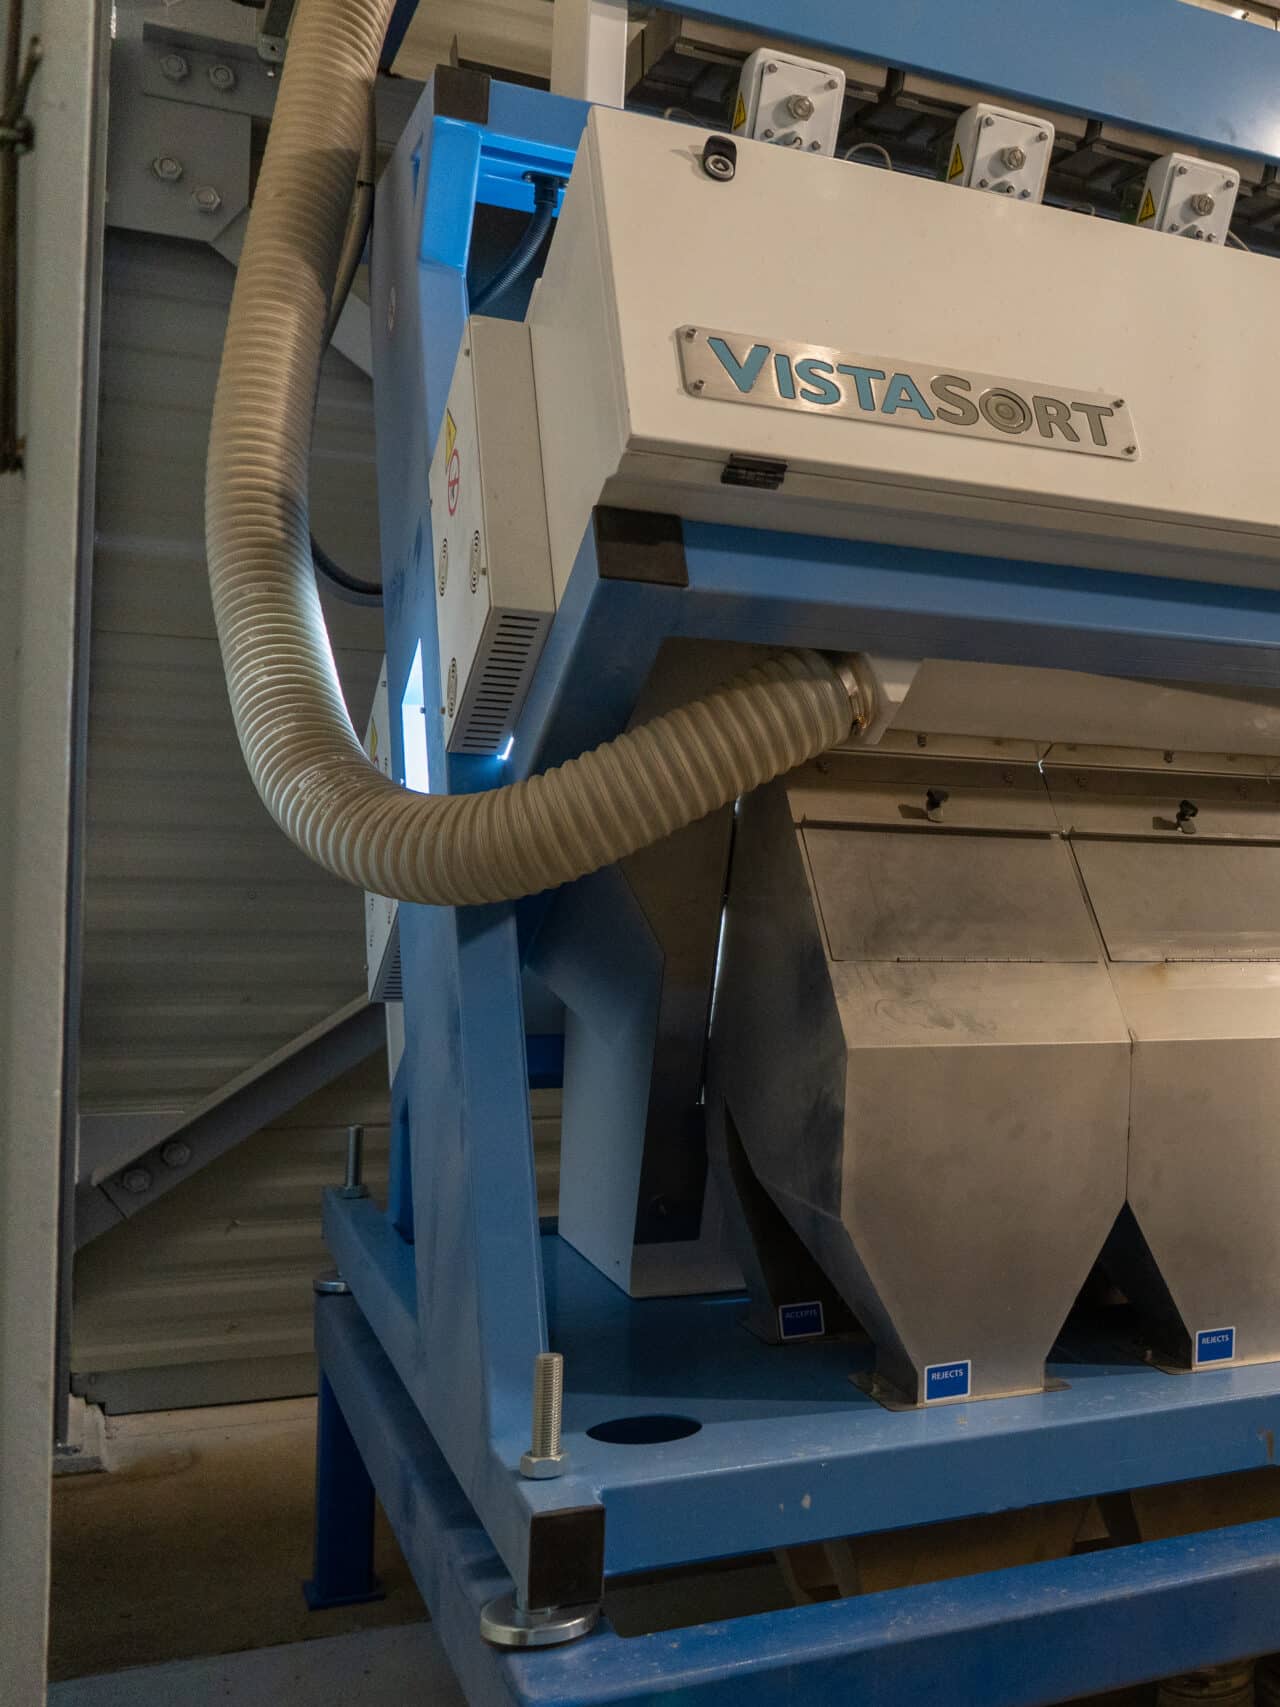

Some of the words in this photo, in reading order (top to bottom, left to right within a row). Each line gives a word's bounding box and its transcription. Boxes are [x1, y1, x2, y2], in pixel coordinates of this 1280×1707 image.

[707, 336, 1114, 447] VISTASORT
[1201, 1334, 1230, 1345] REJECTS
[931, 1368, 964, 1381] REJECTS
